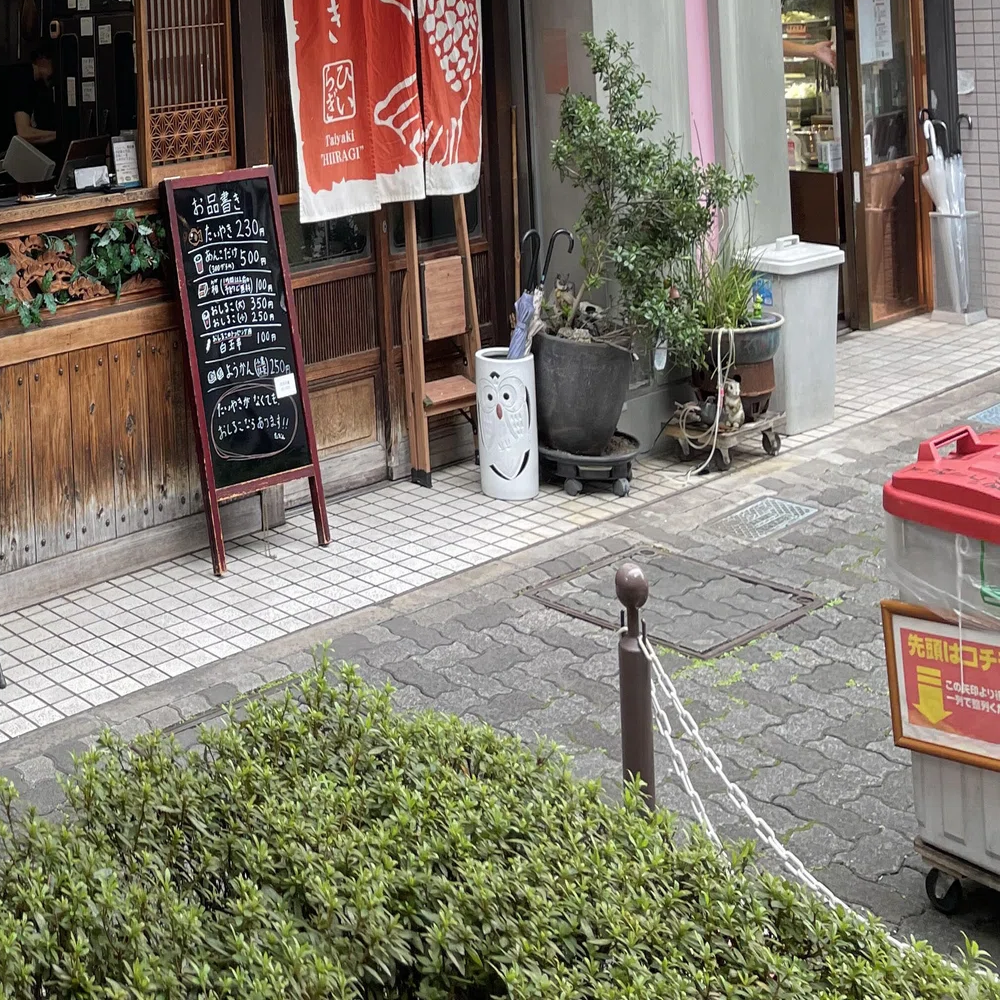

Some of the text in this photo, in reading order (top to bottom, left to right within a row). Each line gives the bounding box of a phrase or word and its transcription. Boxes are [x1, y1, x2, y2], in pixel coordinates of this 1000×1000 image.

[325, 130, 355, 148] Taiyaki
[191, 191, 241, 216] お品書き
[205, 218, 265, 242] たいやき 230円
[205, 247, 266, 267] あんこだけ 500円
[255, 278, 273, 293] 100円
[250, 296, 274, 310] 350円
[251, 311, 275, 323] 250円
[257, 331, 277, 344] 100円
[226, 359, 254, 380] ようかん
[270, 358, 291, 375] 250円
